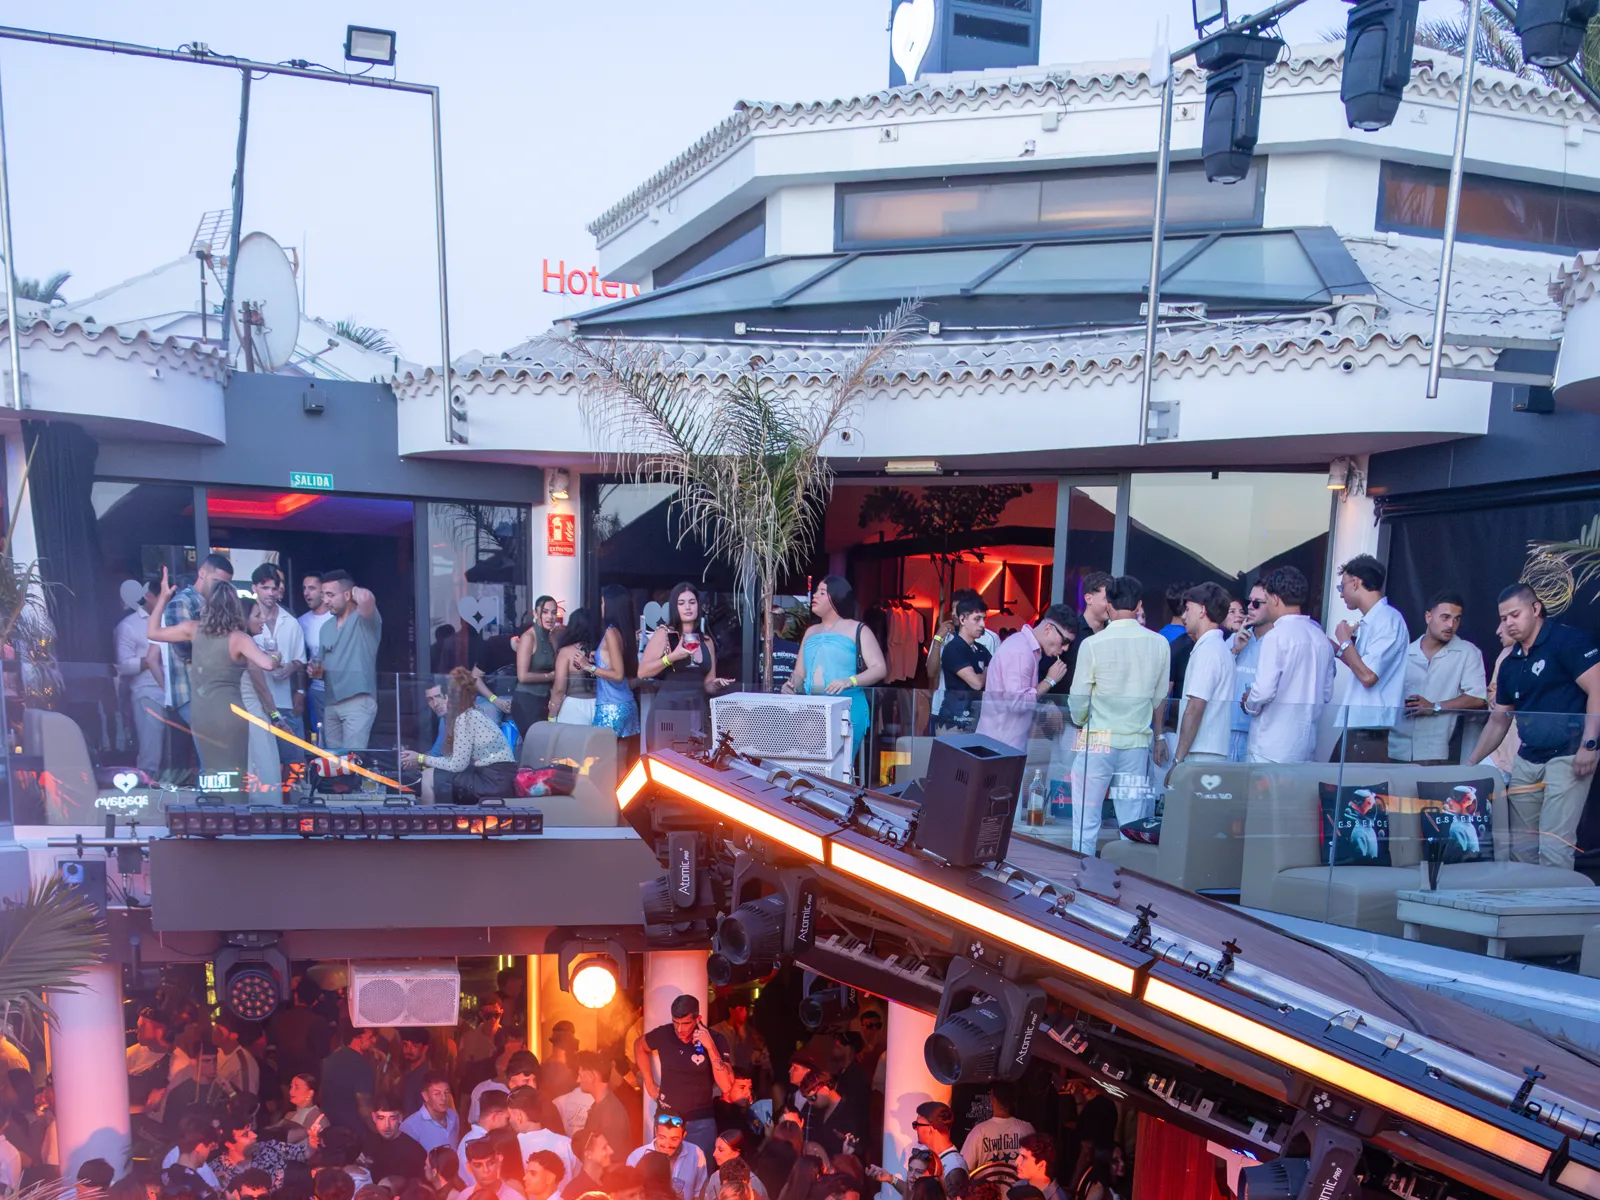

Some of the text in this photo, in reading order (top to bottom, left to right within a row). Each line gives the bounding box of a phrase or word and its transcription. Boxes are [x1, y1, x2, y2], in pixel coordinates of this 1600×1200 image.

[294, 474, 330, 487] SALIDA
[678, 860, 690, 896] Atomic
[798, 905, 812, 942] Atomic
[1015, 1025, 1035, 1065] Atomic
[1003, 1133, 1022, 1150] Gall
